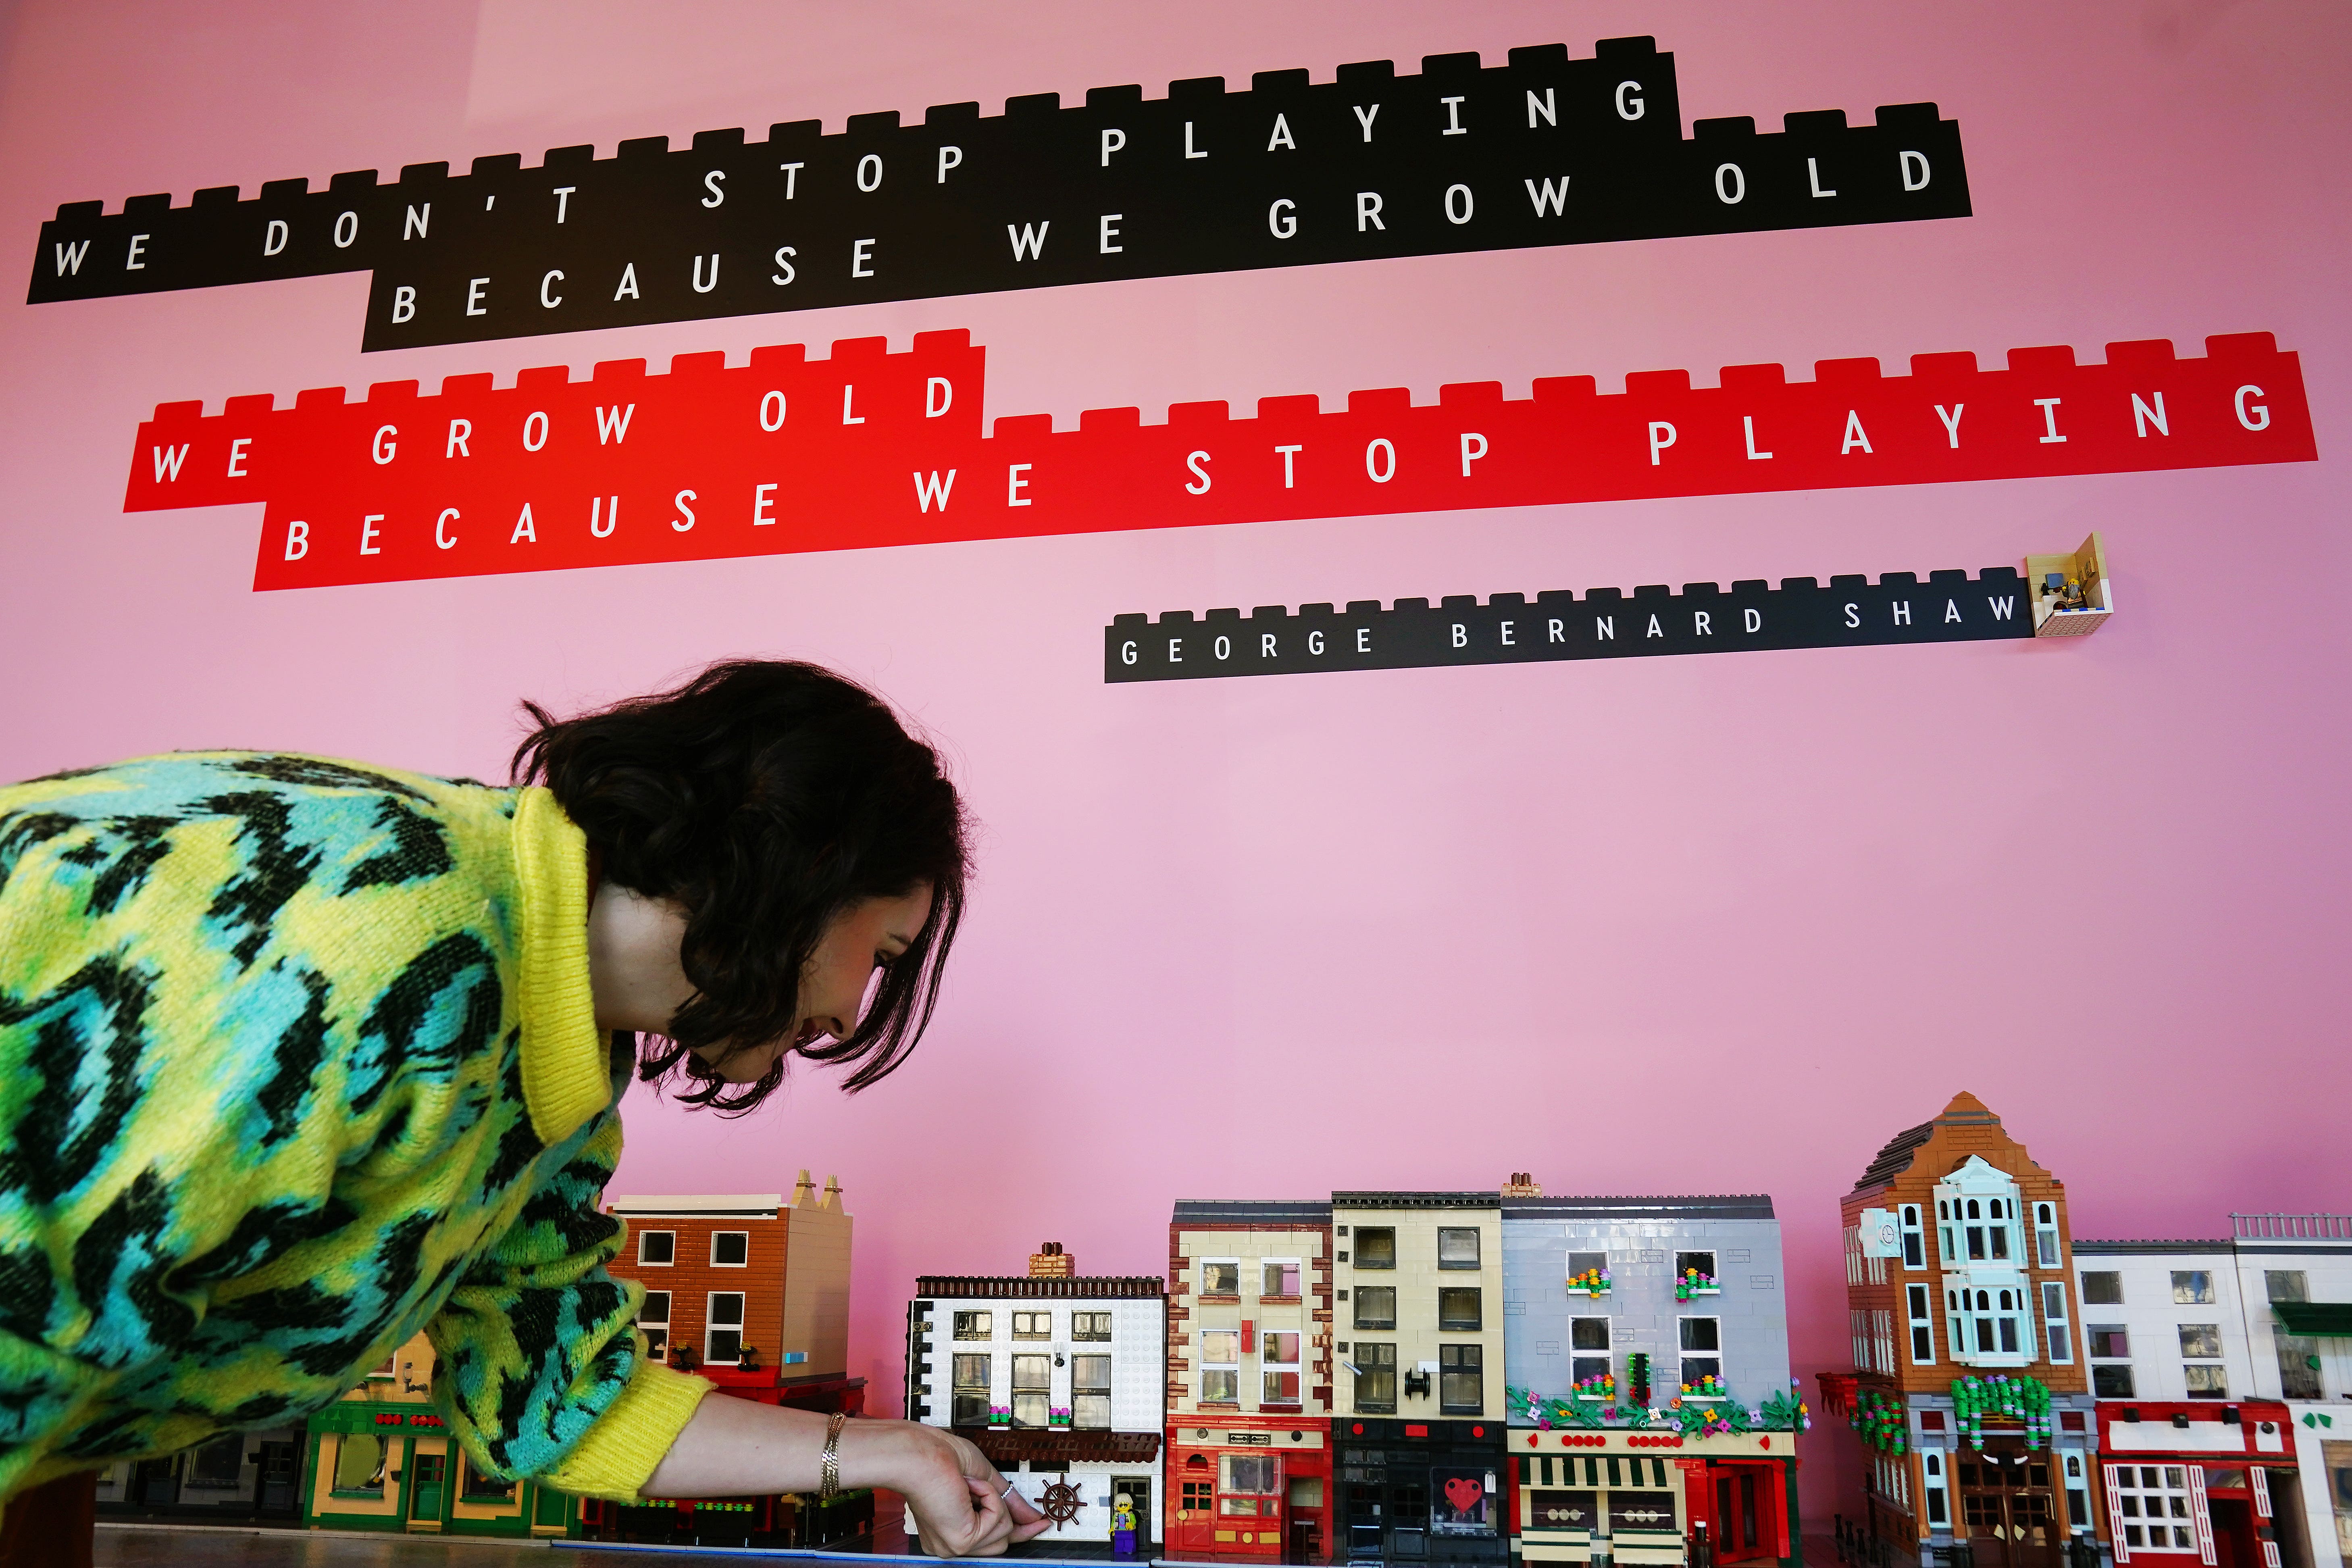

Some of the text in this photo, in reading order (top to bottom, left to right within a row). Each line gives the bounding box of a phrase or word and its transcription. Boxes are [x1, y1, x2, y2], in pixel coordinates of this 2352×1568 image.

[56, 81, 1644, 277] WE DON'T STOP PLAYING
[392, 151, 1930, 324] BECAUSE WE GROW OLD
[154, 377, 952, 483] WE GROW OLD
[285, 385, 2270, 561] BECAUSE WE STOP PLAYING
[1122, 596, 2014, 665] GEORGE BERNARD SHAW
